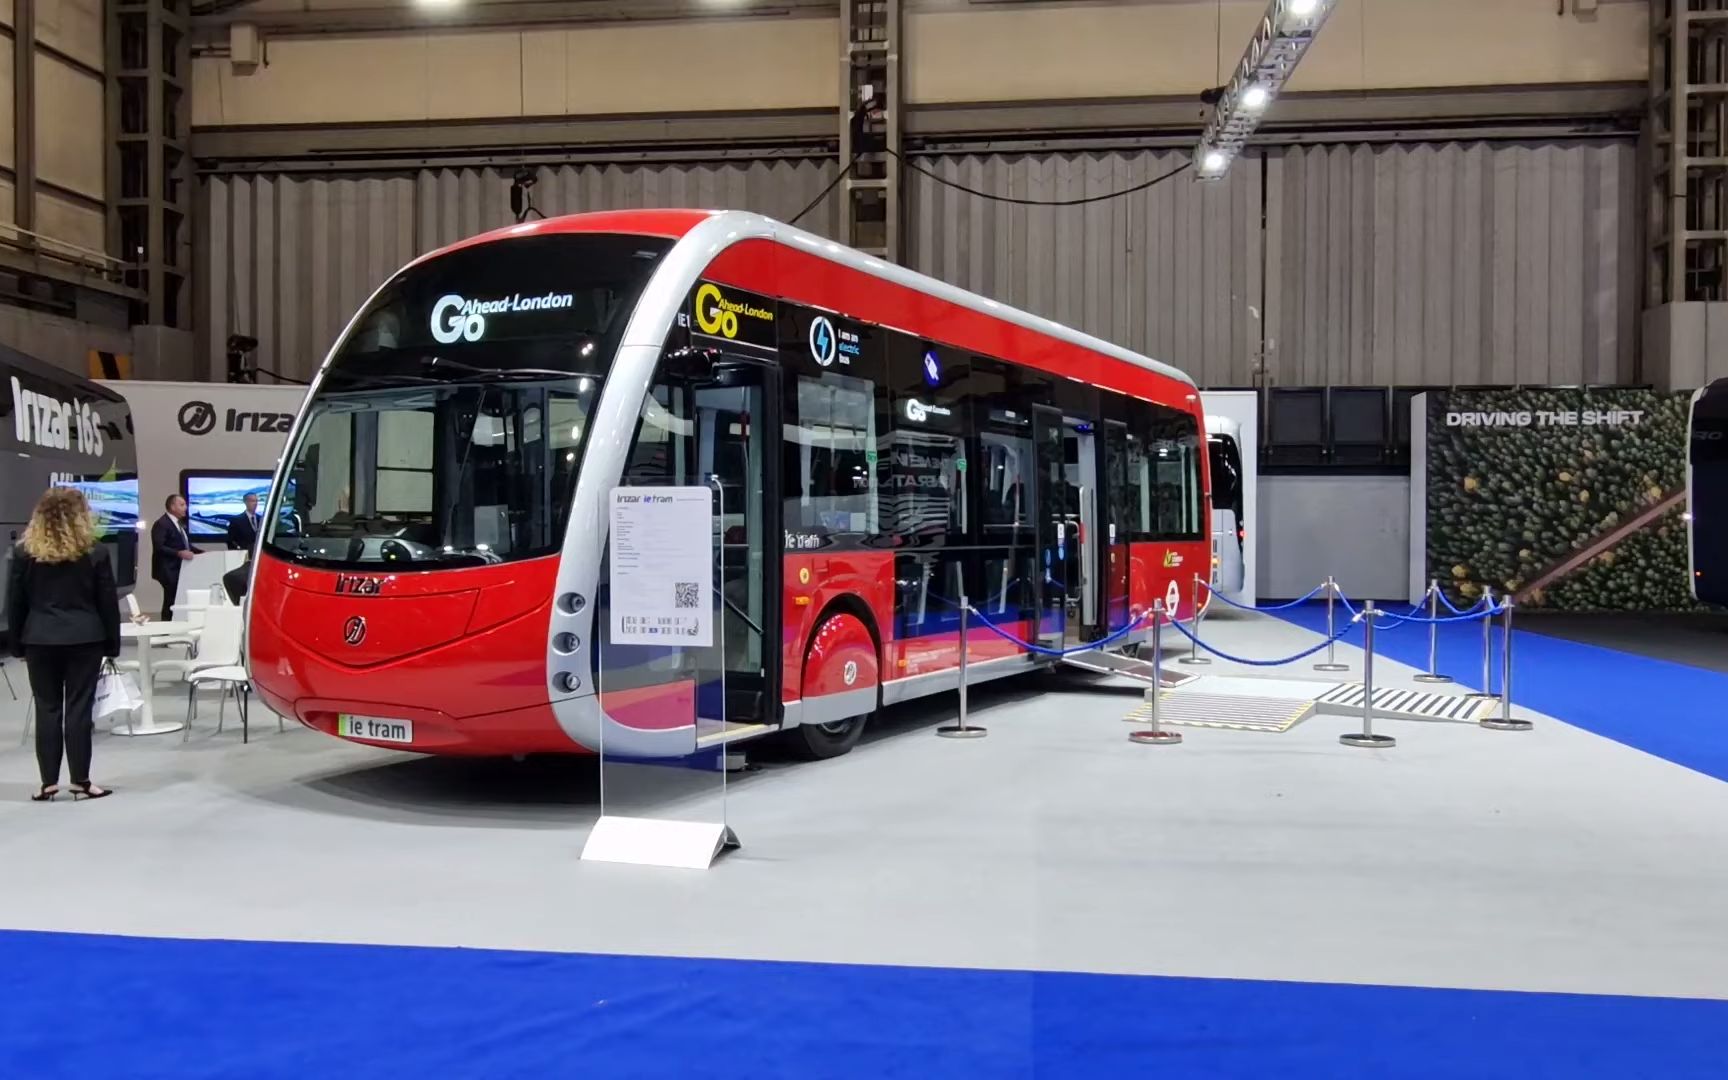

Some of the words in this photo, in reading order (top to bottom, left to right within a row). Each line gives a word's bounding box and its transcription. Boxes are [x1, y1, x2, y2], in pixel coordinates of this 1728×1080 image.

[430, 294, 485, 343] Go
[461, 292, 573, 315] Ahead-London
[695, 283, 738, 338] Go
[718, 298, 773, 321] Ahead-London
[838, 353, 850, 365] bus
[839, 342, 860, 355] electric
[10, 375, 72, 450] Irizar
[74, 397, 103, 457] i6s
[225, 408, 295, 432] Iriza
[1446, 411, 1532, 426] DRIVING
[1535, 411, 1579, 426] THE
[1581, 410, 1644, 425] SHIFT
[616, 494, 641, 504] Irizar
[334, 573, 384, 595] Irizar
[349, 715, 363, 735] ie
[367, 719, 406, 739] tram
